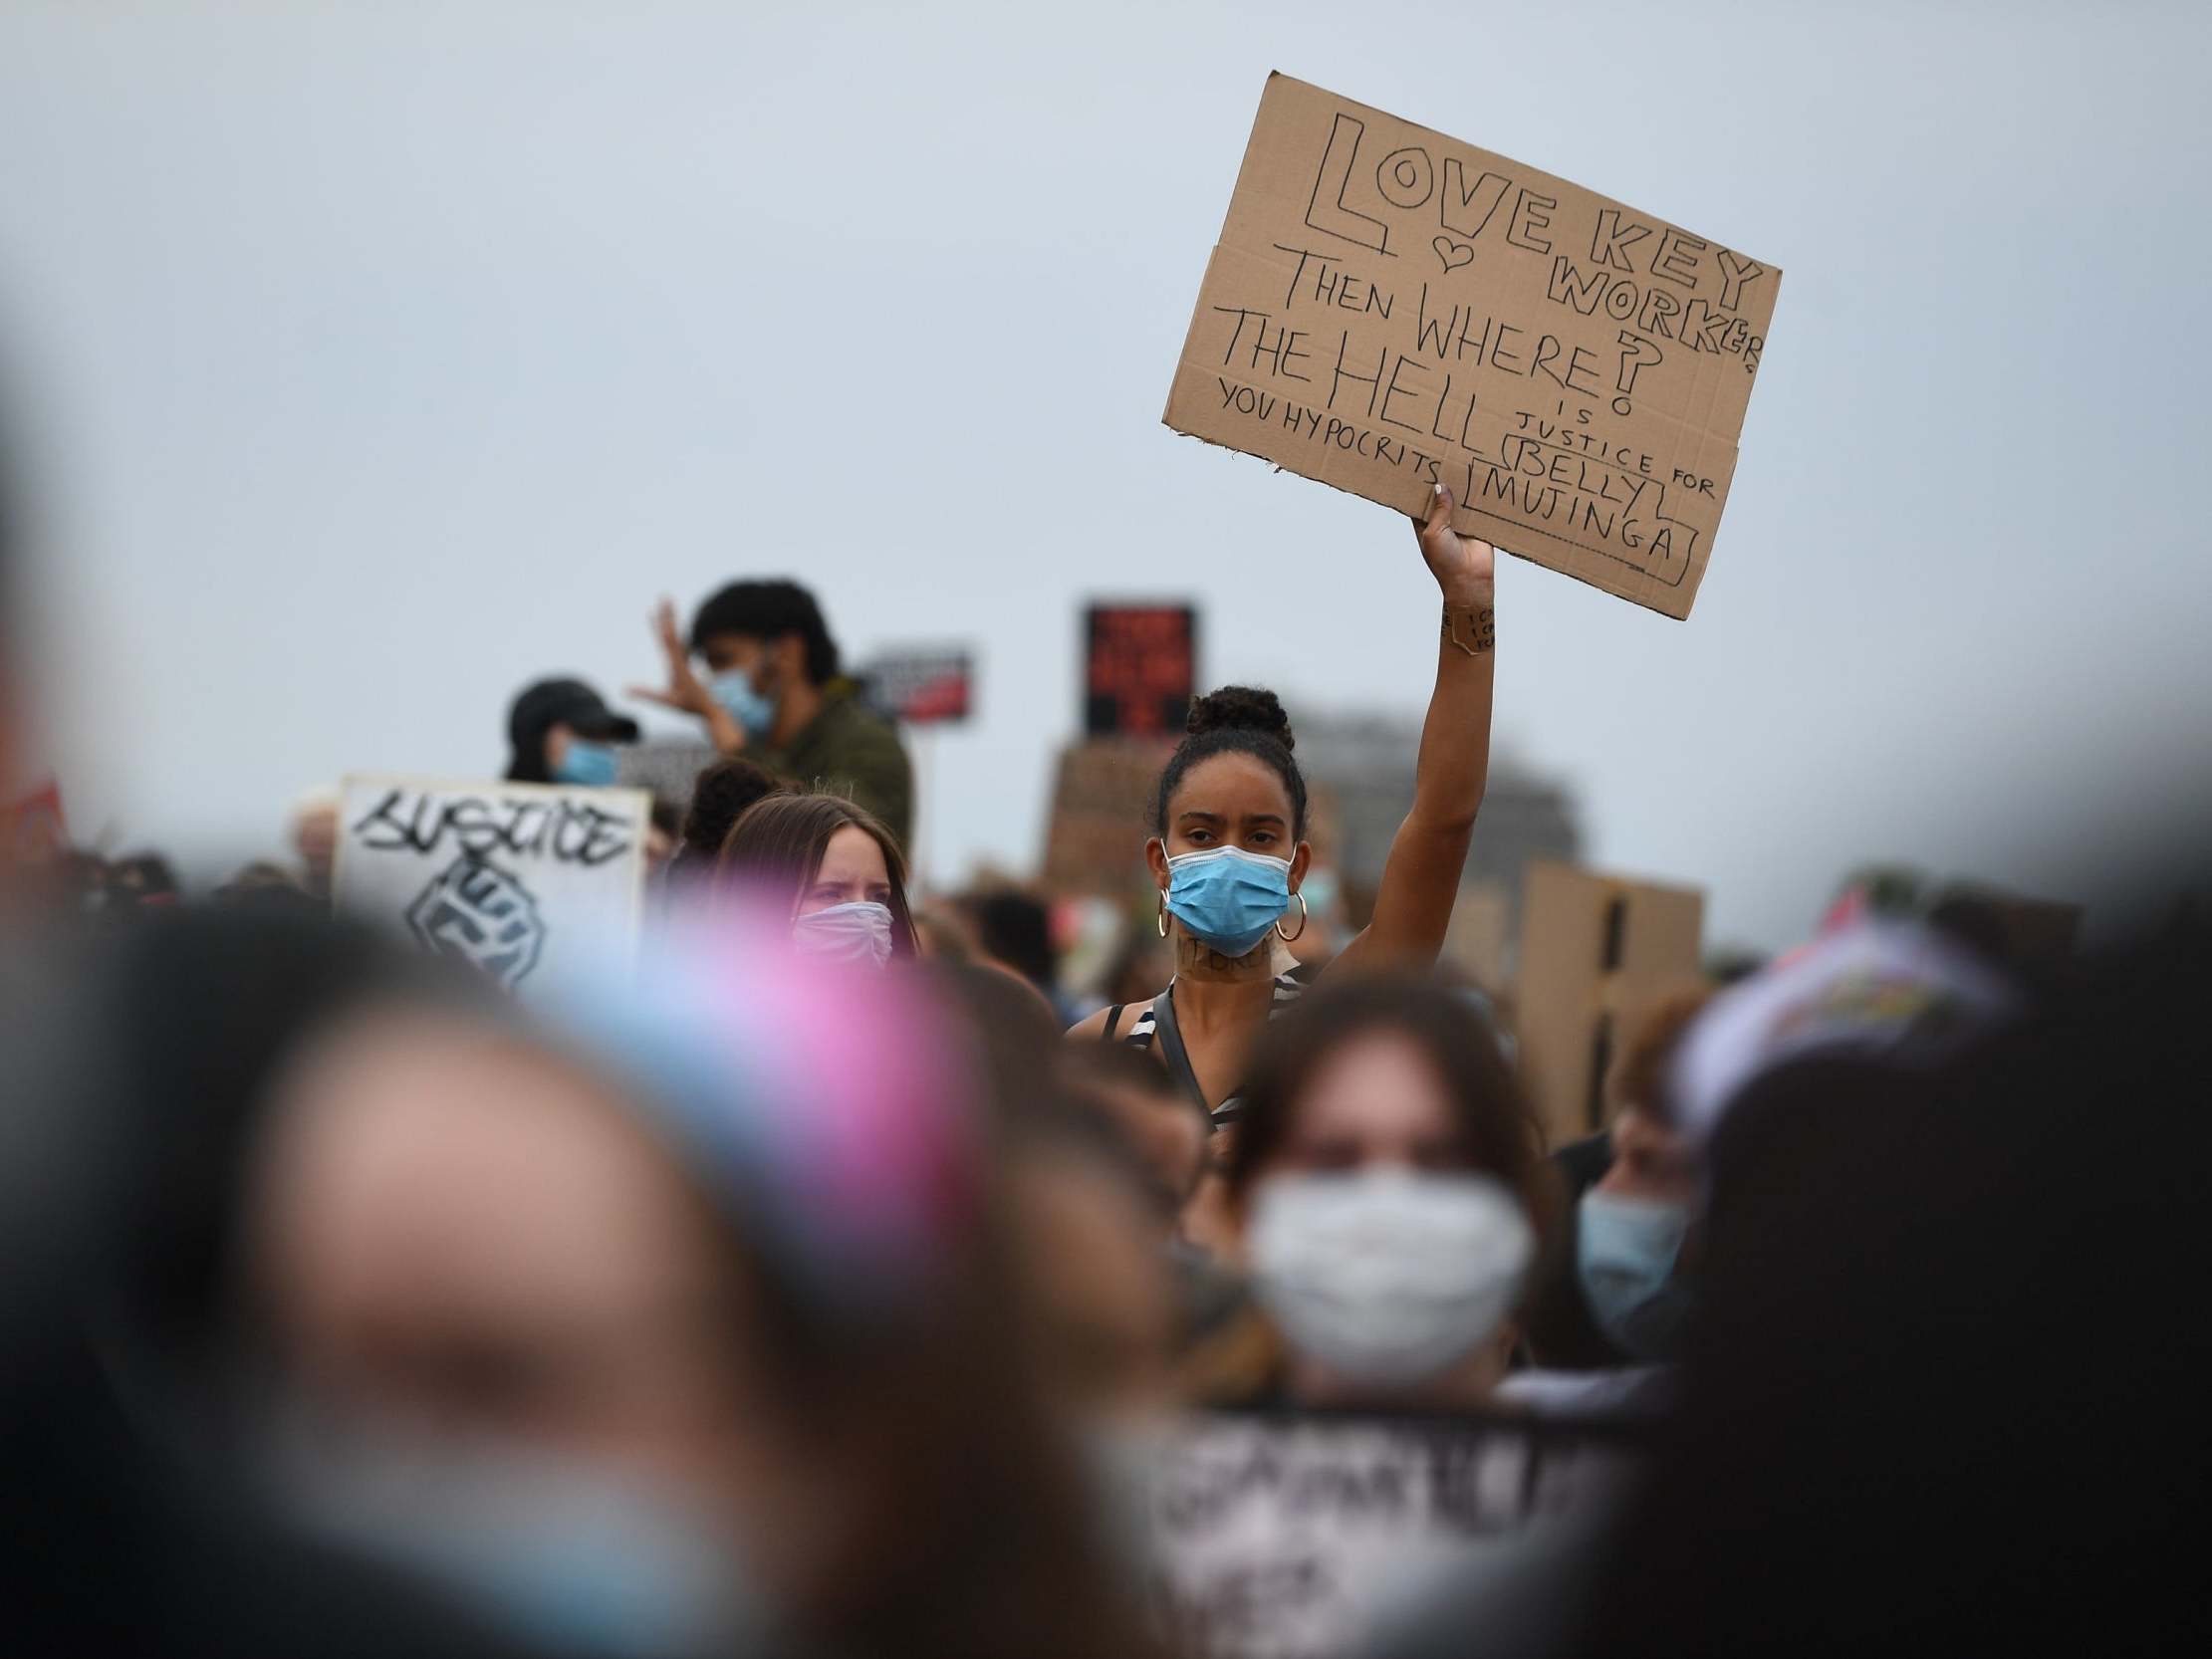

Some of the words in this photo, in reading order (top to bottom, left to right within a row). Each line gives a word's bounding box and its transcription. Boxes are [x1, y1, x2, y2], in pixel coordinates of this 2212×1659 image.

[1306, 113, 1556, 257] LOVE
[1591, 209, 1763, 311] KEY
[1273, 244, 1394, 320] THEN
[1214, 307, 1311, 381] THE
[1328, 331, 1483, 454] HELL
[1558, 400, 1593, 424] IS
[1219, 377, 1275, 420] YOU
[1284, 402, 1441, 485] HYPOCRITS
[1516, 411, 1653, 473] JUSTICE
[1672, 468, 1715, 500] FOR
[1483, 467, 1671, 560] MUJINGA
[1514, 439, 1646, 518] BELLY
